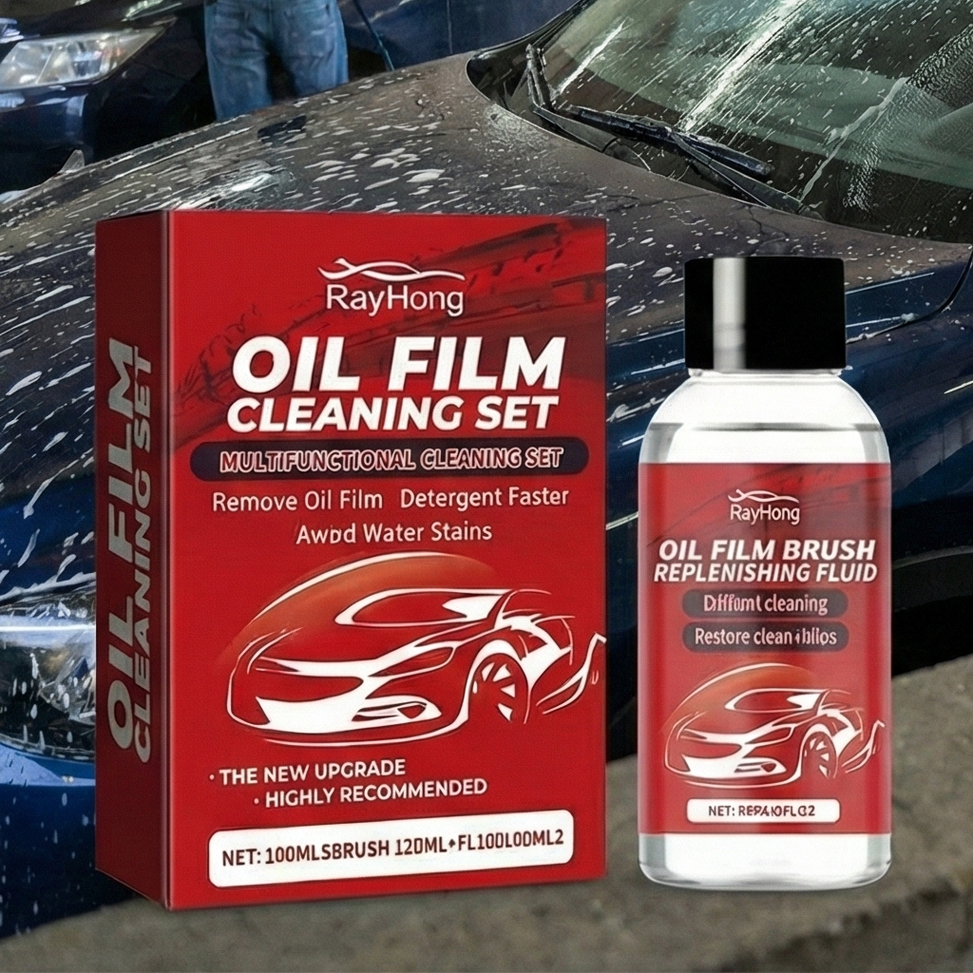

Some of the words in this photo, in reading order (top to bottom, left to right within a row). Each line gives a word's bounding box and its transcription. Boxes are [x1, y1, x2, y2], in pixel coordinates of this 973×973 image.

[326, 284, 465, 318] RayHong
[231, 335, 361, 394] OIL
[388, 336, 567, 392] FILM
[134, 346, 152, 453] SET
[226, 396, 464, 433] CLEANING
[474, 396, 561, 430] SET
[107, 337, 134, 563] FILM
[219, 448, 416, 474] MULTIFUNCTIONAL
[420, 447, 522, 470] CLEANING
[525, 446, 564, 468] SET
[212, 492, 298, 512] Remove
[304, 490, 332, 510] Oil
[340, 488, 383, 509] Film
[400, 487, 503, 512] Detergent
[508, 486, 570, 506] Faster
[729, 504, 801, 525] RayHong
[363, 523, 424, 543] Water
[431, 520, 493, 541] Stains
[658, 539, 703, 561] OIL
[710, 539, 776, 561] FILM
[782, 539, 876, 561] BRUSH
[653, 563, 811, 583] REPLENISHING
[815, 563, 878, 583] FLUID
[134, 468, 151, 763] CLEANING
[764, 593, 829, 616] cleaning
[695, 627, 751, 645] Restore
[107, 595, 134, 750] OIL
[219, 767, 258, 786] THE
[264, 765, 309, 784] NEW
[314, 759, 406, 781] UPGRADE
[265, 787, 335, 808] HIGHLY
[340, 778, 488, 804] RECOMMENDED
[708, 805, 735, 817] NET:
[222, 848, 261, 867] NET:
[265, 839, 390, 865] 100MLSBRUSH
